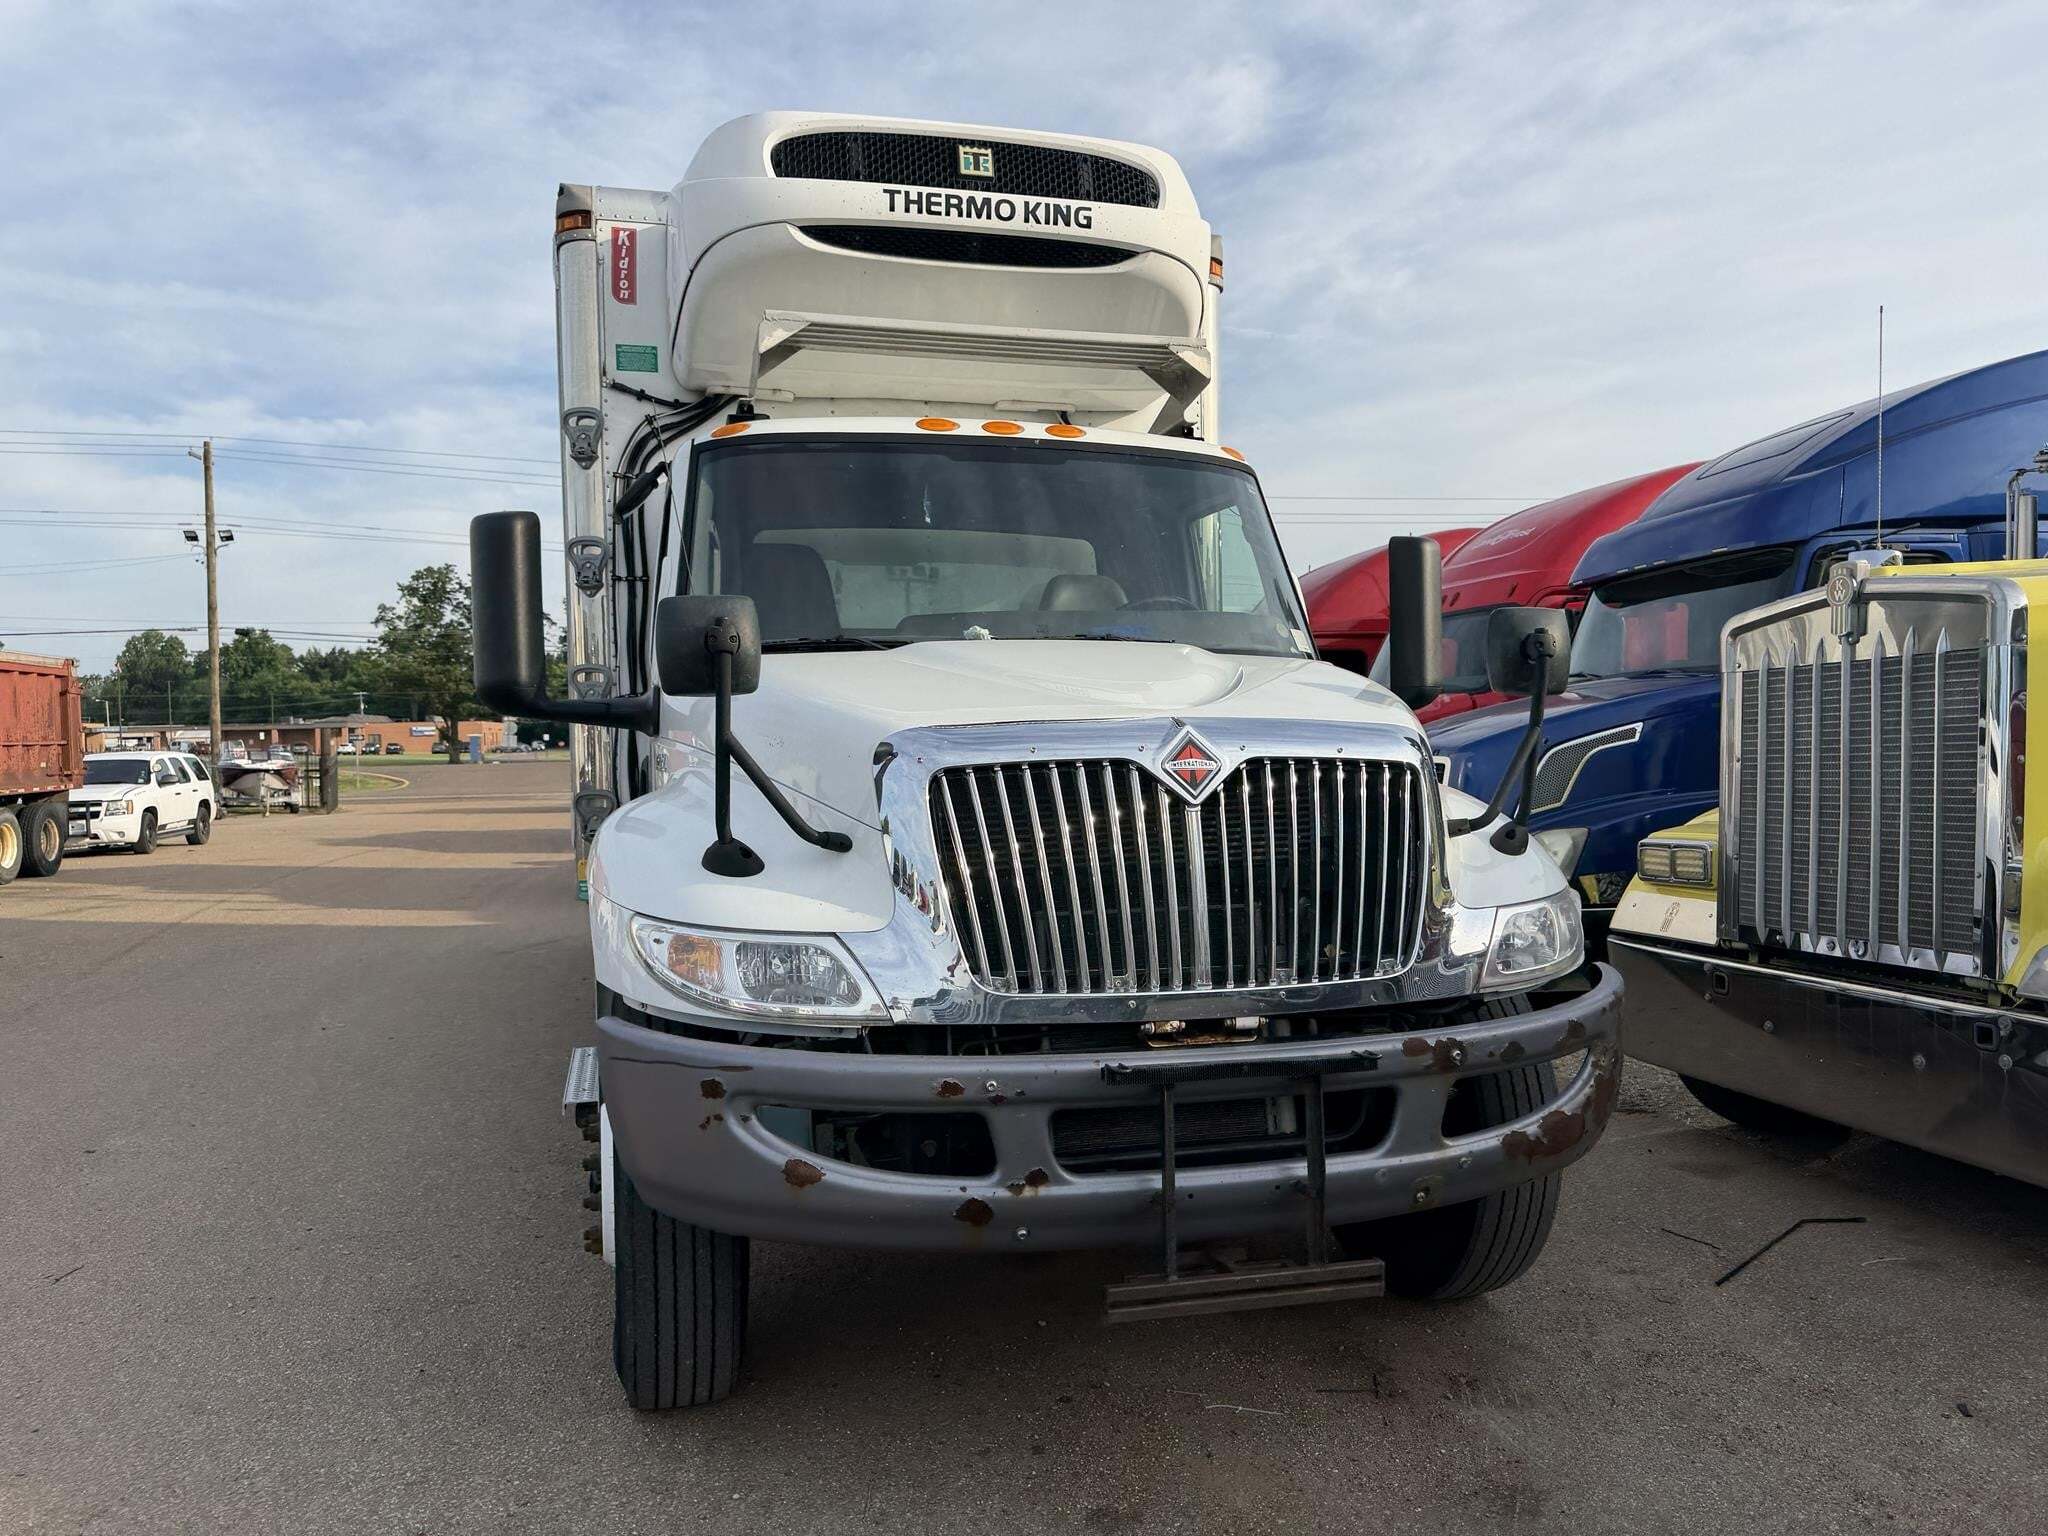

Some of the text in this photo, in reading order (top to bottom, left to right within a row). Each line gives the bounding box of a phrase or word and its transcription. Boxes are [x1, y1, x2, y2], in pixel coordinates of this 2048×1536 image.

[882, 188, 1093, 230] THERMO KING
[617, 230, 631, 299] Kidron
[1170, 759, 1215, 768] INTERNATIONAL
